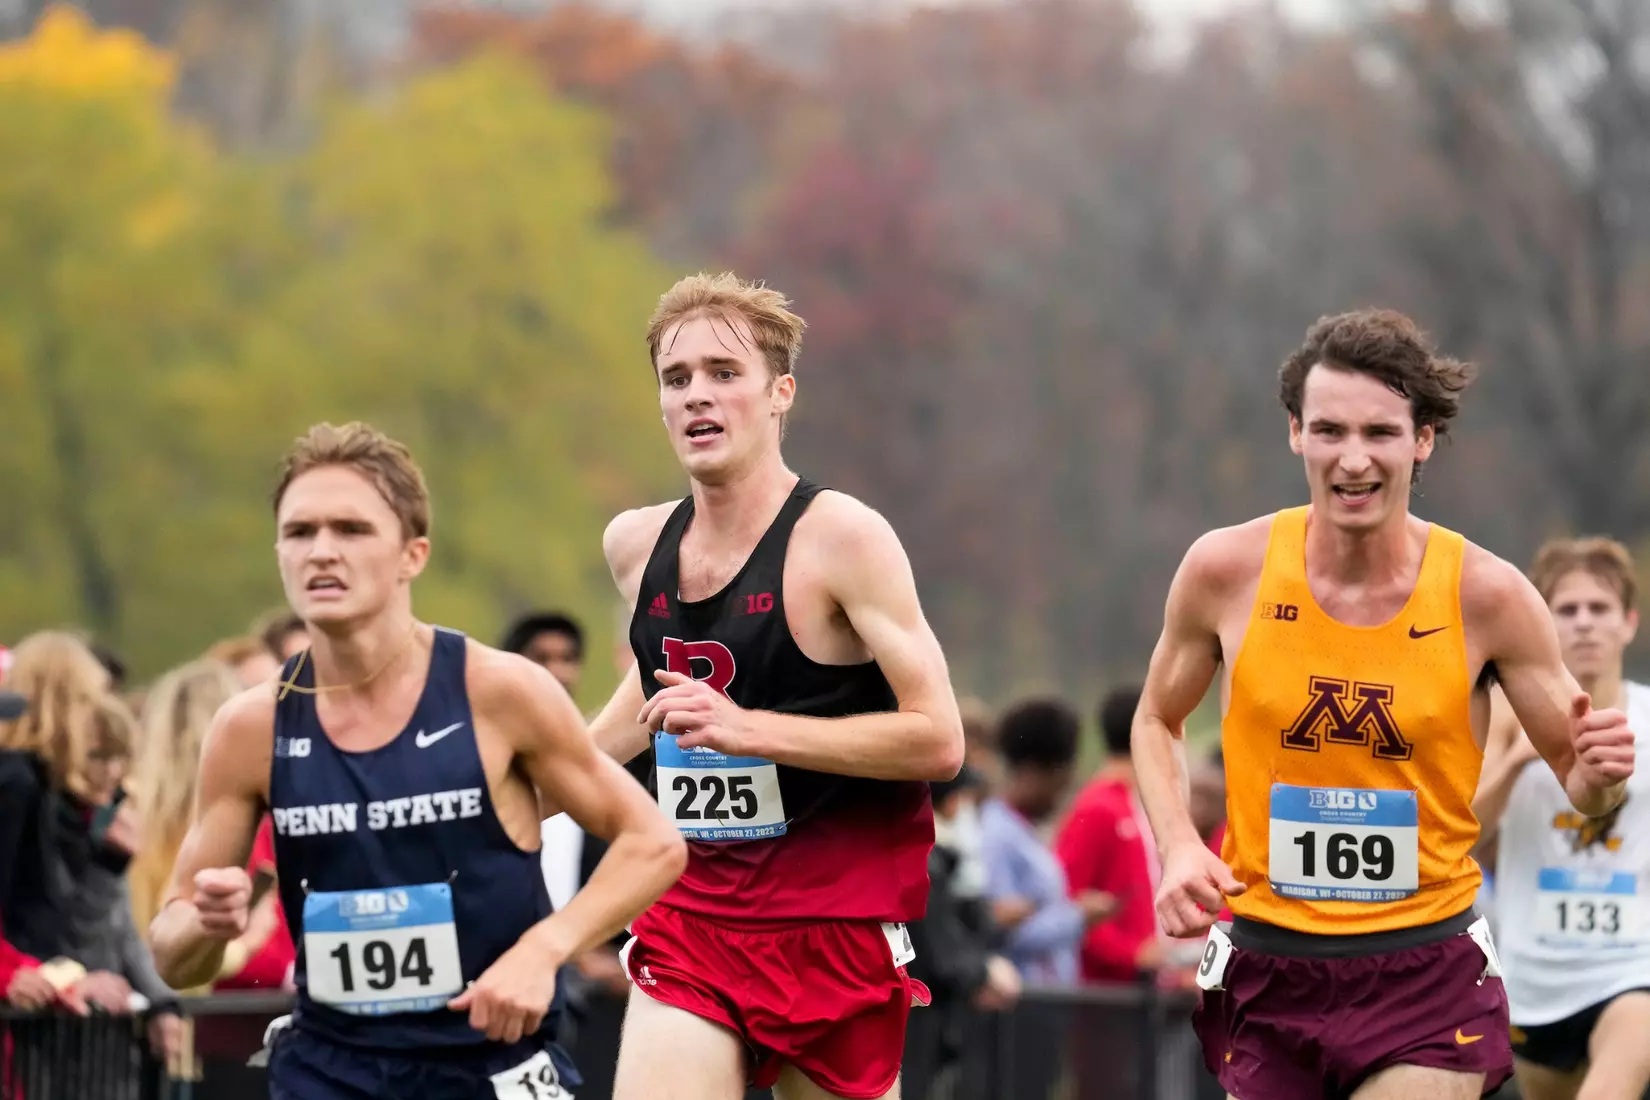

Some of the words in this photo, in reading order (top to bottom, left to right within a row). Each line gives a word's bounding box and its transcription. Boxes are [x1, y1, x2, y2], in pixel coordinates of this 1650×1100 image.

[1281, 675, 1414, 761] M
[272, 803, 358, 837] PENN
[366, 787, 482, 830] STATE
[672, 775, 758, 820] 225
[714, 829, 744, 839] OCTOBER
[756, 827, 775, 836] 2023
[1294, 831, 1395, 882] 169
[1336, 889, 1371, 900] OCTOBER
[1386, 891, 1406, 900] 2023
[1556, 901, 1620, 934] 133
[330, 938, 434, 992] 194
[1200, 940, 1218, 975] 9
